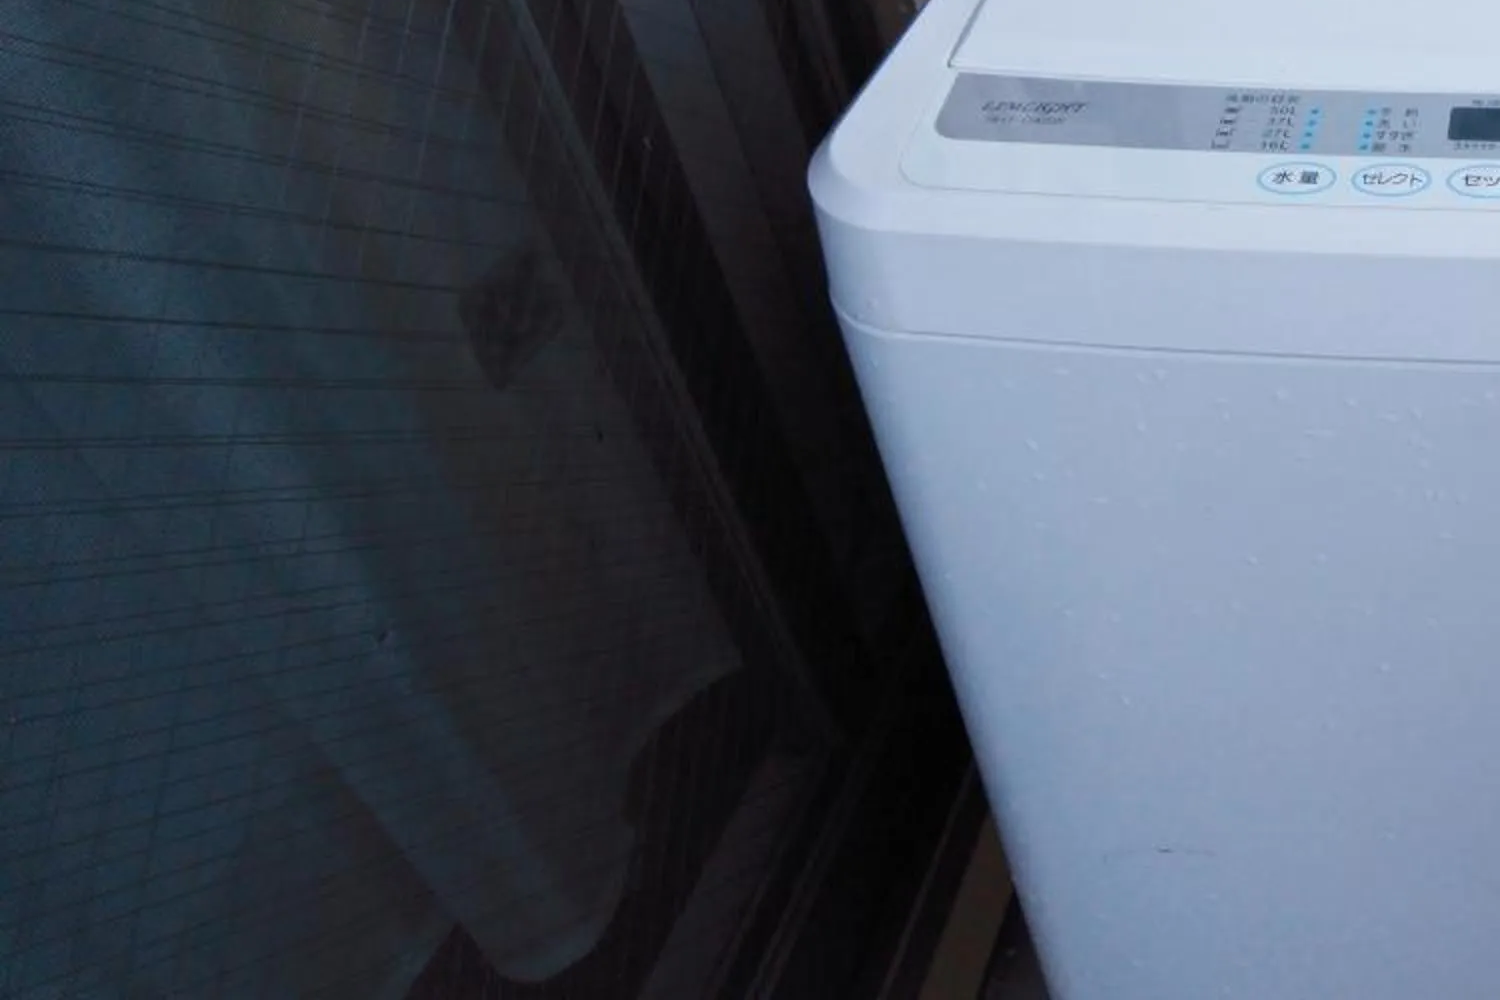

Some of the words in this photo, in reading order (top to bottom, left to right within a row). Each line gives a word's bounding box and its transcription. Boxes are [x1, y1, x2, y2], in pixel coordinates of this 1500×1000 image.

[1271, 170, 1320, 185] 水量
[1362, 172, 1423, 188] セレクト
